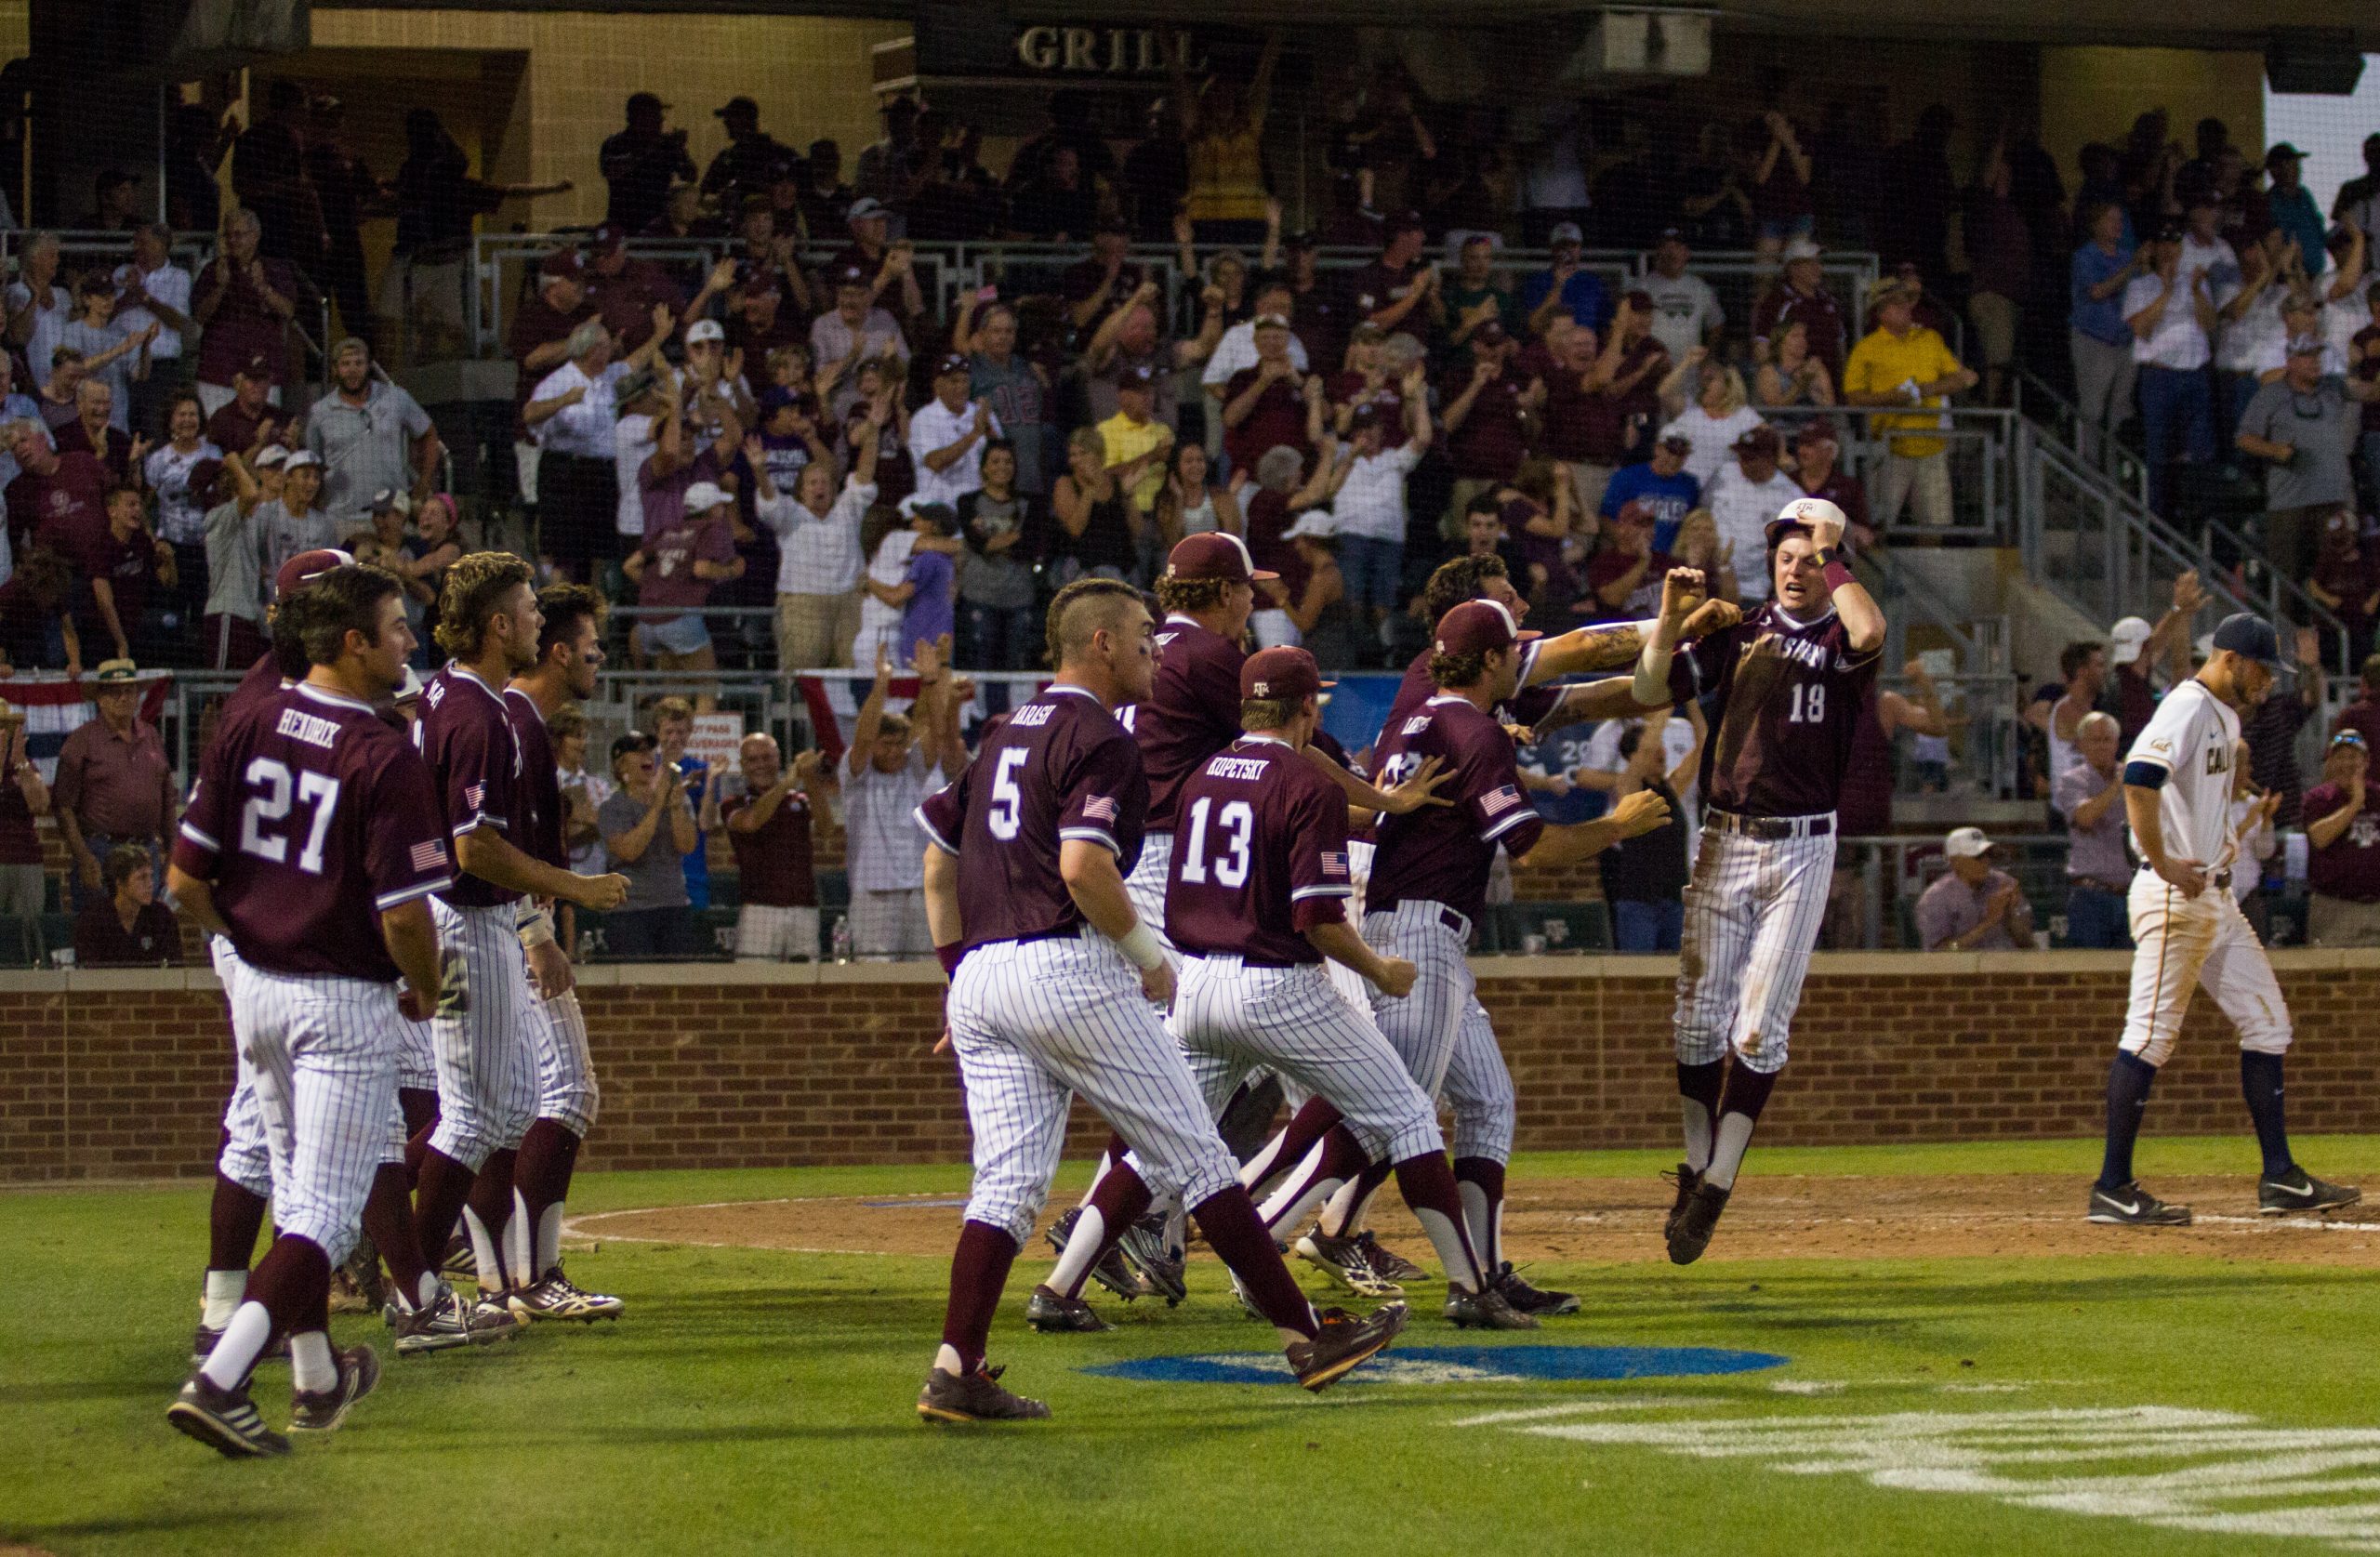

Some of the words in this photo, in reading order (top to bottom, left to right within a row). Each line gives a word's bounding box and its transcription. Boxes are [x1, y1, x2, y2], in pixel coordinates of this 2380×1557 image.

[1018, 24, 1209, 73] GRILL
[1010, 705, 1057, 725] BARASH
[1790, 683, 1826, 723] 18
[276, 707, 341, 749] HENDRIX
[1207, 757, 1270, 780] KOPETSKY
[240, 756, 341, 875] 27
[988, 747, 1030, 840] 5
[1181, 797, 1253, 889] 13
